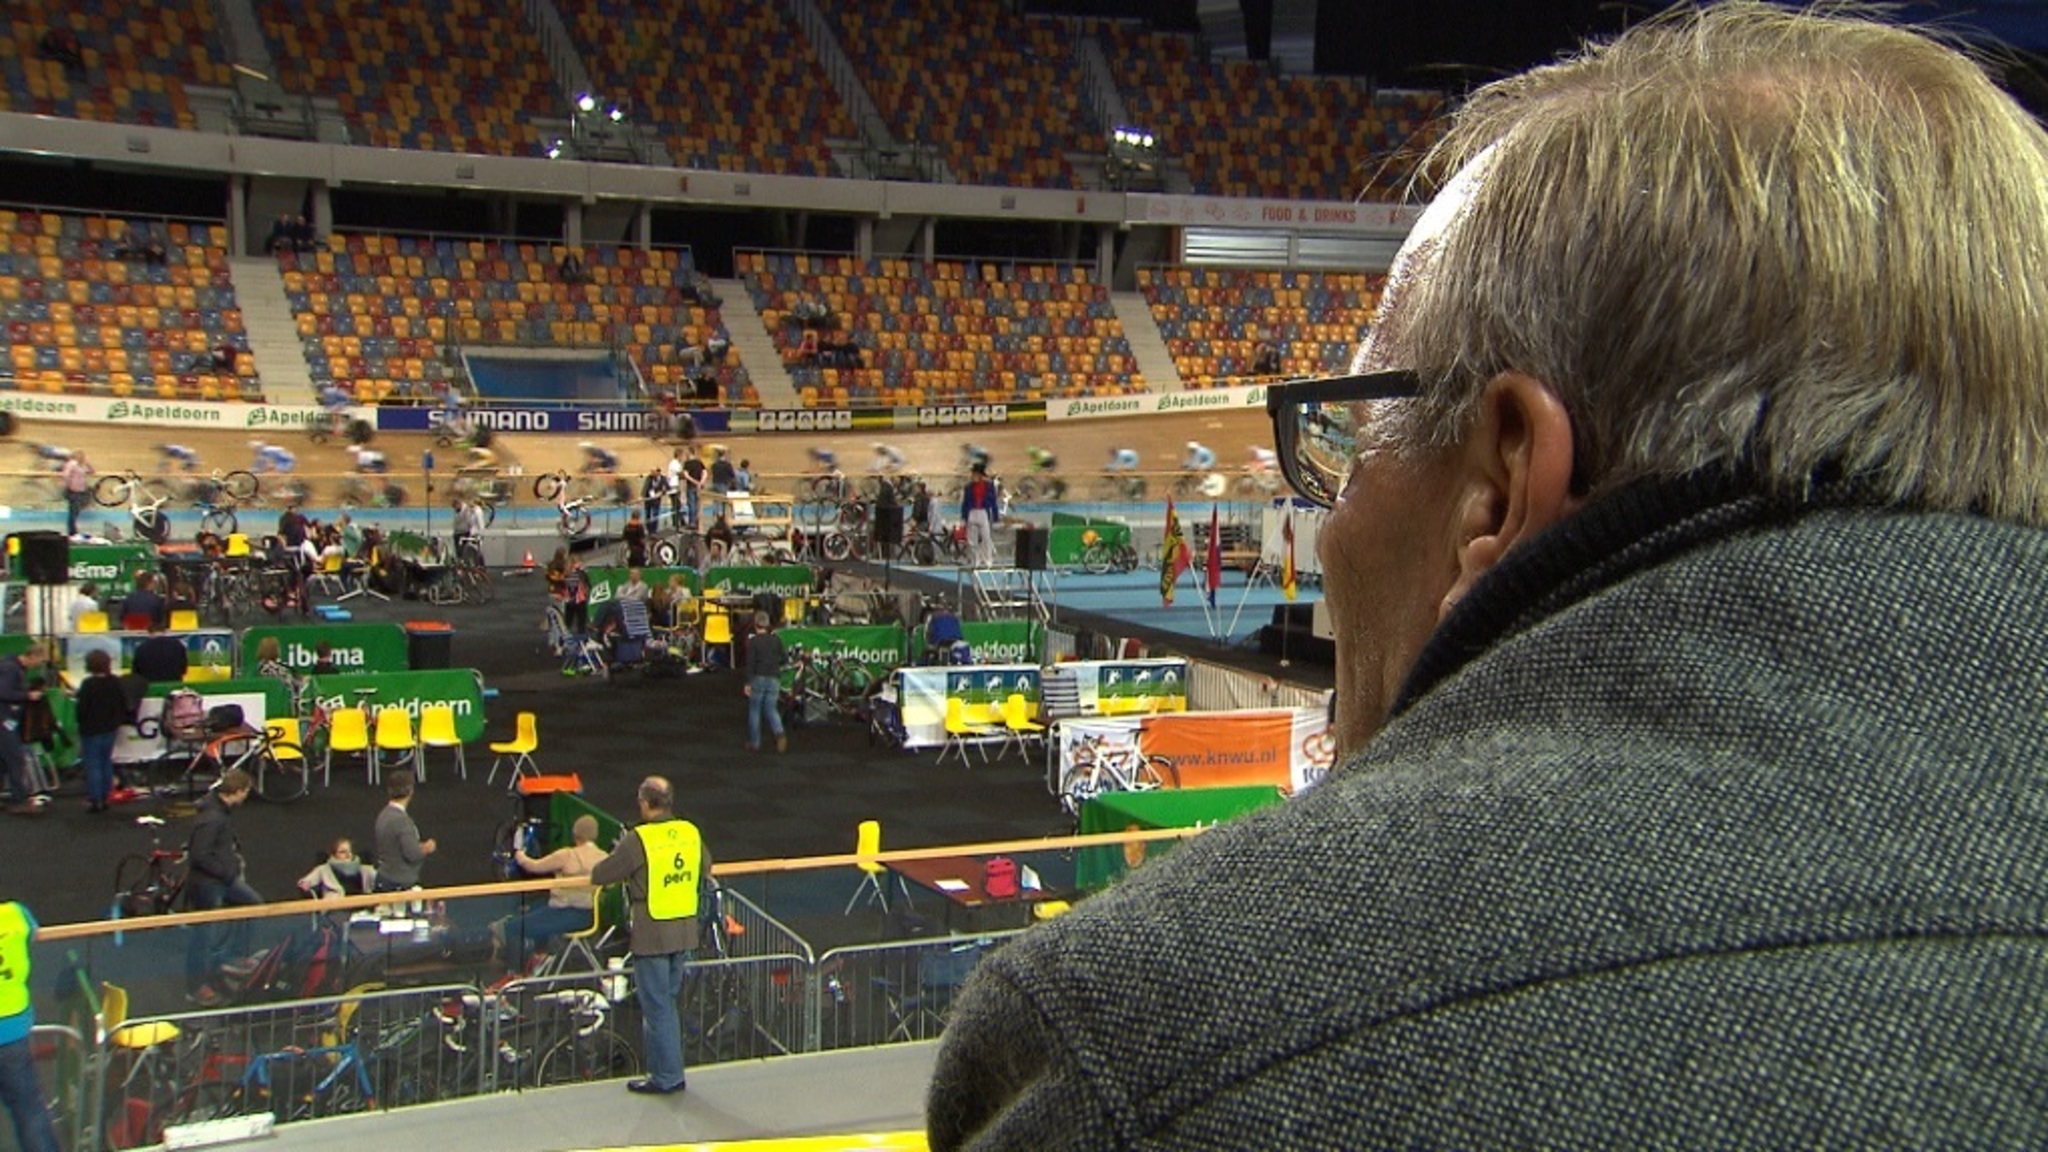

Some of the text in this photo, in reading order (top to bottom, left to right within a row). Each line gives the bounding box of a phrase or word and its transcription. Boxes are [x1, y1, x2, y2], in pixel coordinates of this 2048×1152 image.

[1262, 207, 1356, 223] FOOD & DRINKS
[0, 398, 77, 414] eldoorn
[1082, 400, 1140, 413] Apeldoorn
[1172, 394, 1230, 408] Apeldoorn
[132, 404, 220, 420] Apeldoorn
[673, 852, 685, 870] 6
